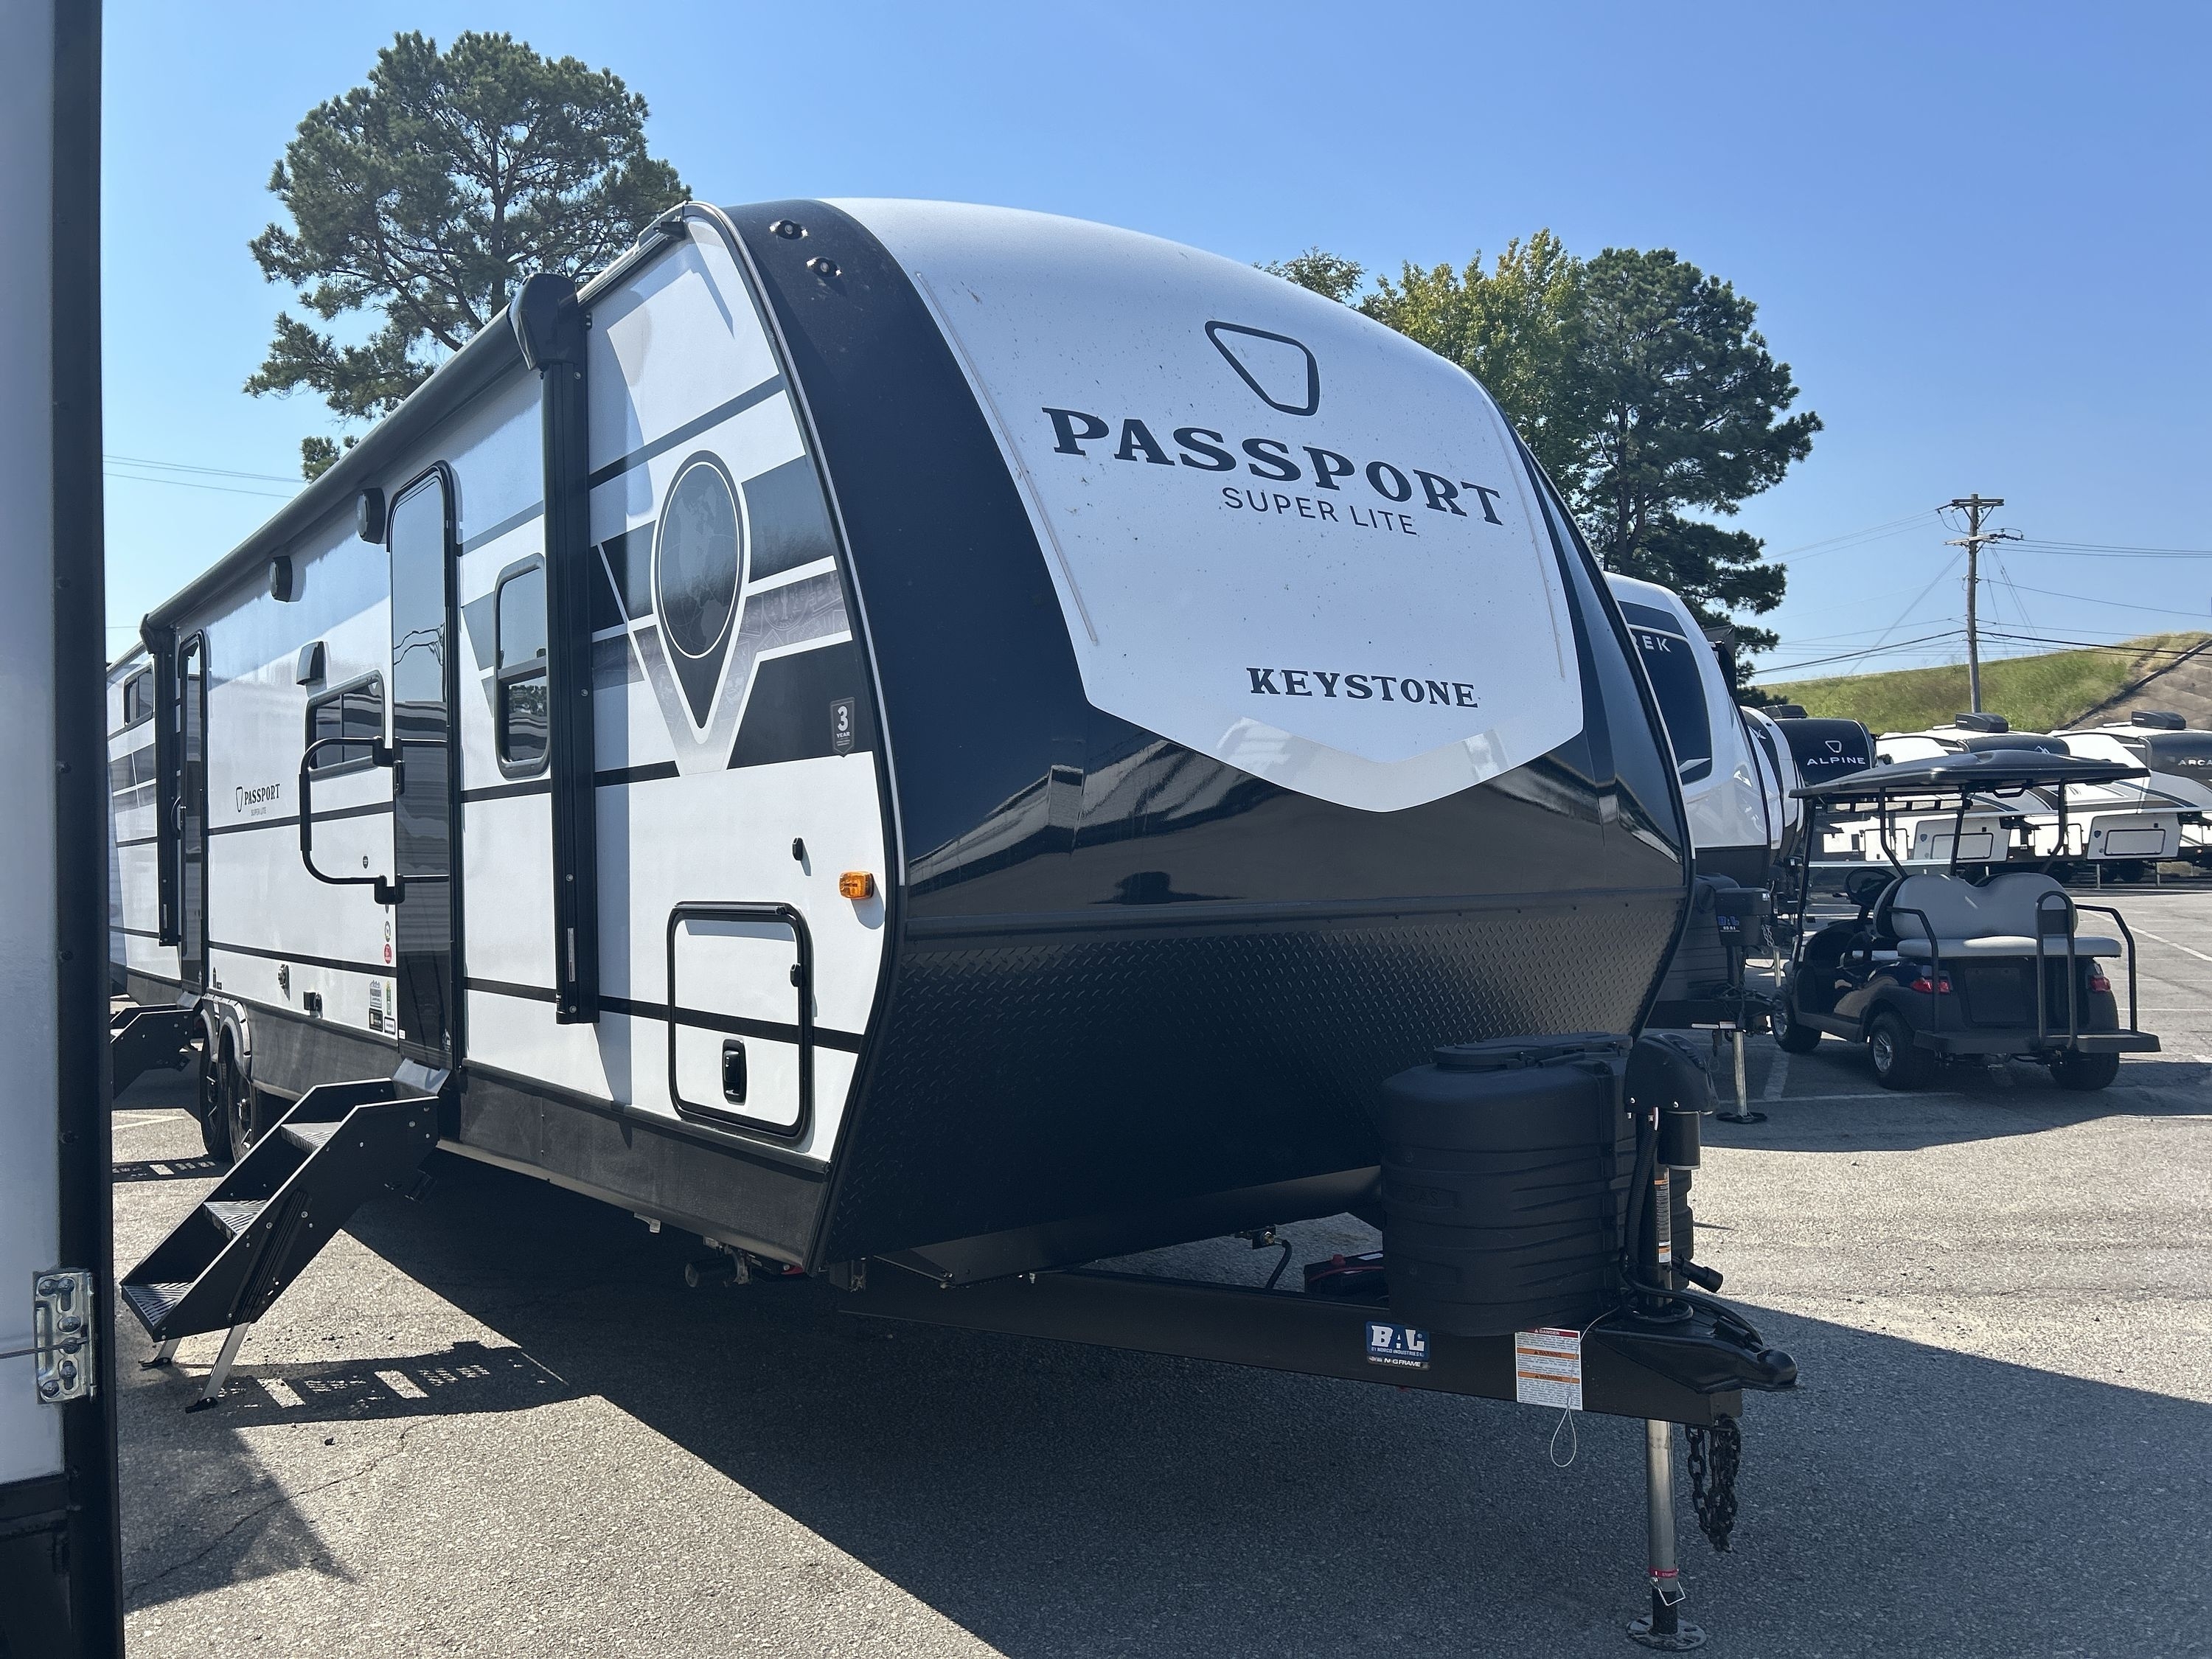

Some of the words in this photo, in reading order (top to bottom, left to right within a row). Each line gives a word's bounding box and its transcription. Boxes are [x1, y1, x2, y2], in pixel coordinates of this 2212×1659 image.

[1042, 407, 1504, 526] PASSPORT
[1222, 487, 1339, 523] SUPER
[1350, 505, 1418, 535] LITE
[1246, 667, 1478, 709] KEYSTONE
[837, 706, 849, 731] 3
[1806, 757, 1866, 766] ALPINE
[244, 784, 280, 805] PASSPORT
[1371, 1325, 1425, 1352] BAL
